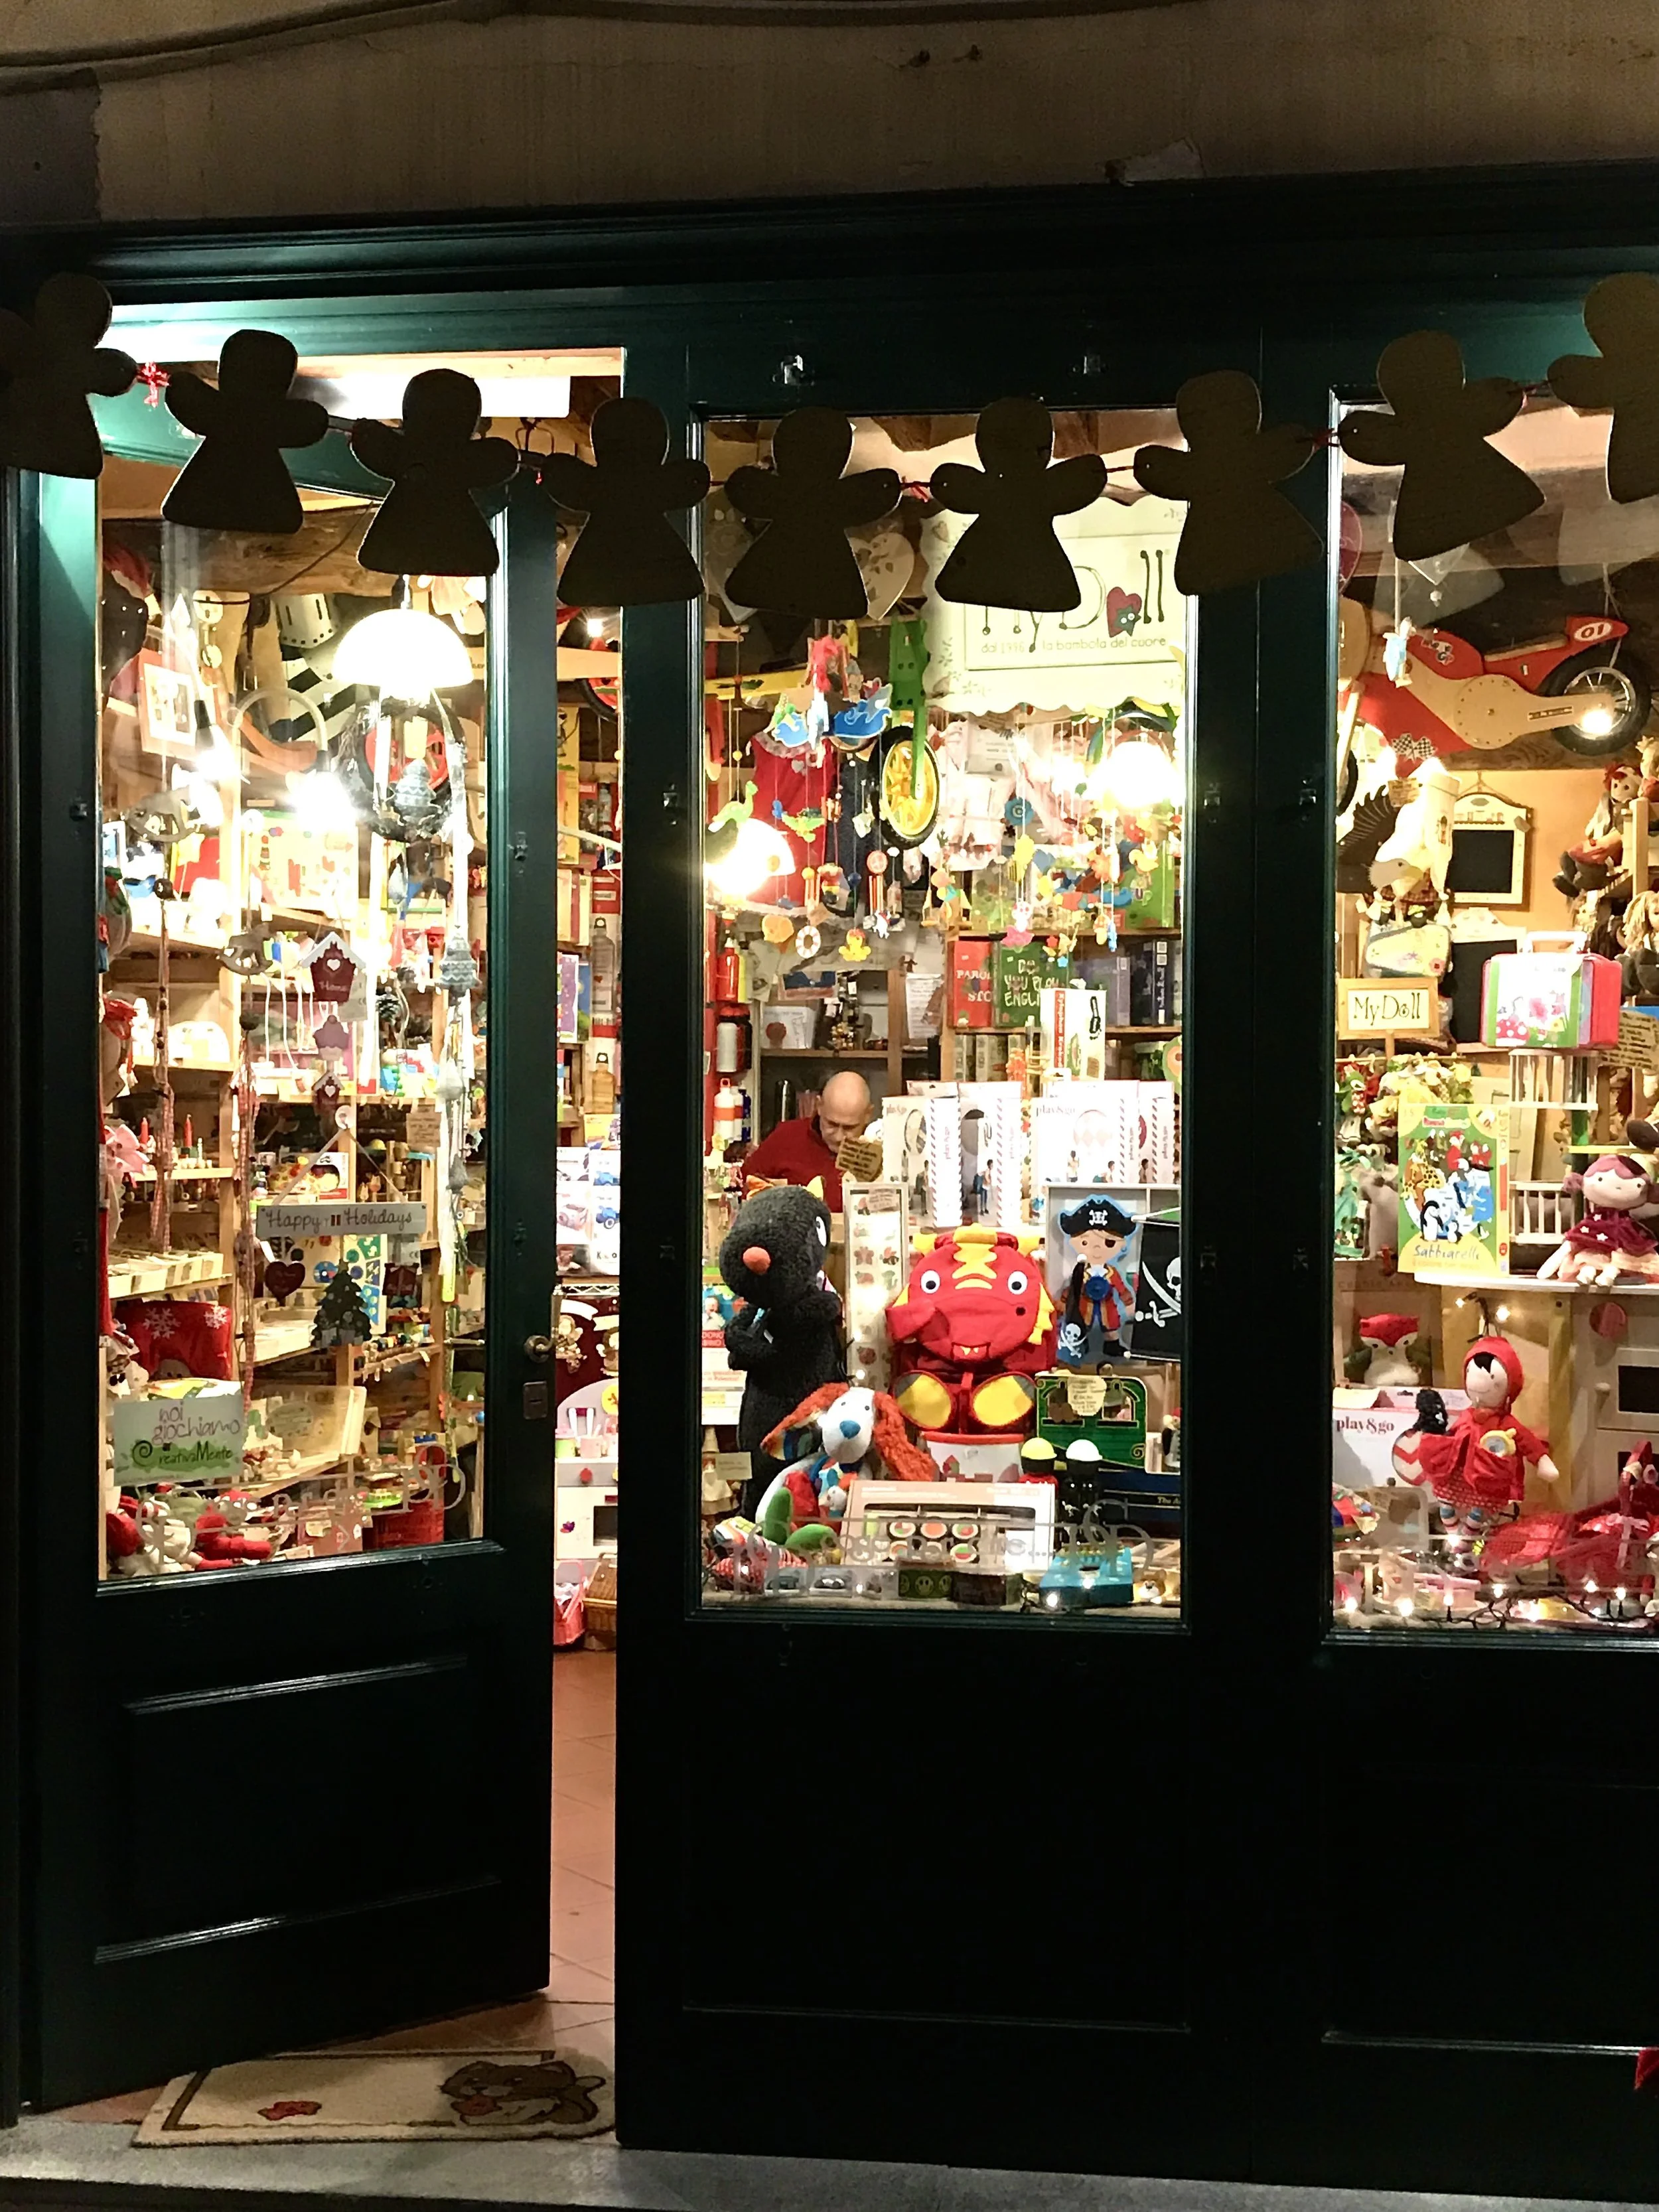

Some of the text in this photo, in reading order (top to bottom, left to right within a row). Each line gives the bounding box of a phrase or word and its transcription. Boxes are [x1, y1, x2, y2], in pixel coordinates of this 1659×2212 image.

[1581, 624, 1605, 639] 01
[1056, 637, 1106, 650] bambola
[1112, 636, 1127, 648] del
[1131, 638, 1166, 648] cuore
[266, 1208, 413, 1234] Happy Holidays
[159, 1400, 184, 1422] noi
[151, 1416, 241, 1446] giochiamo
[1336, 1416, 1396, 1435] play&go
